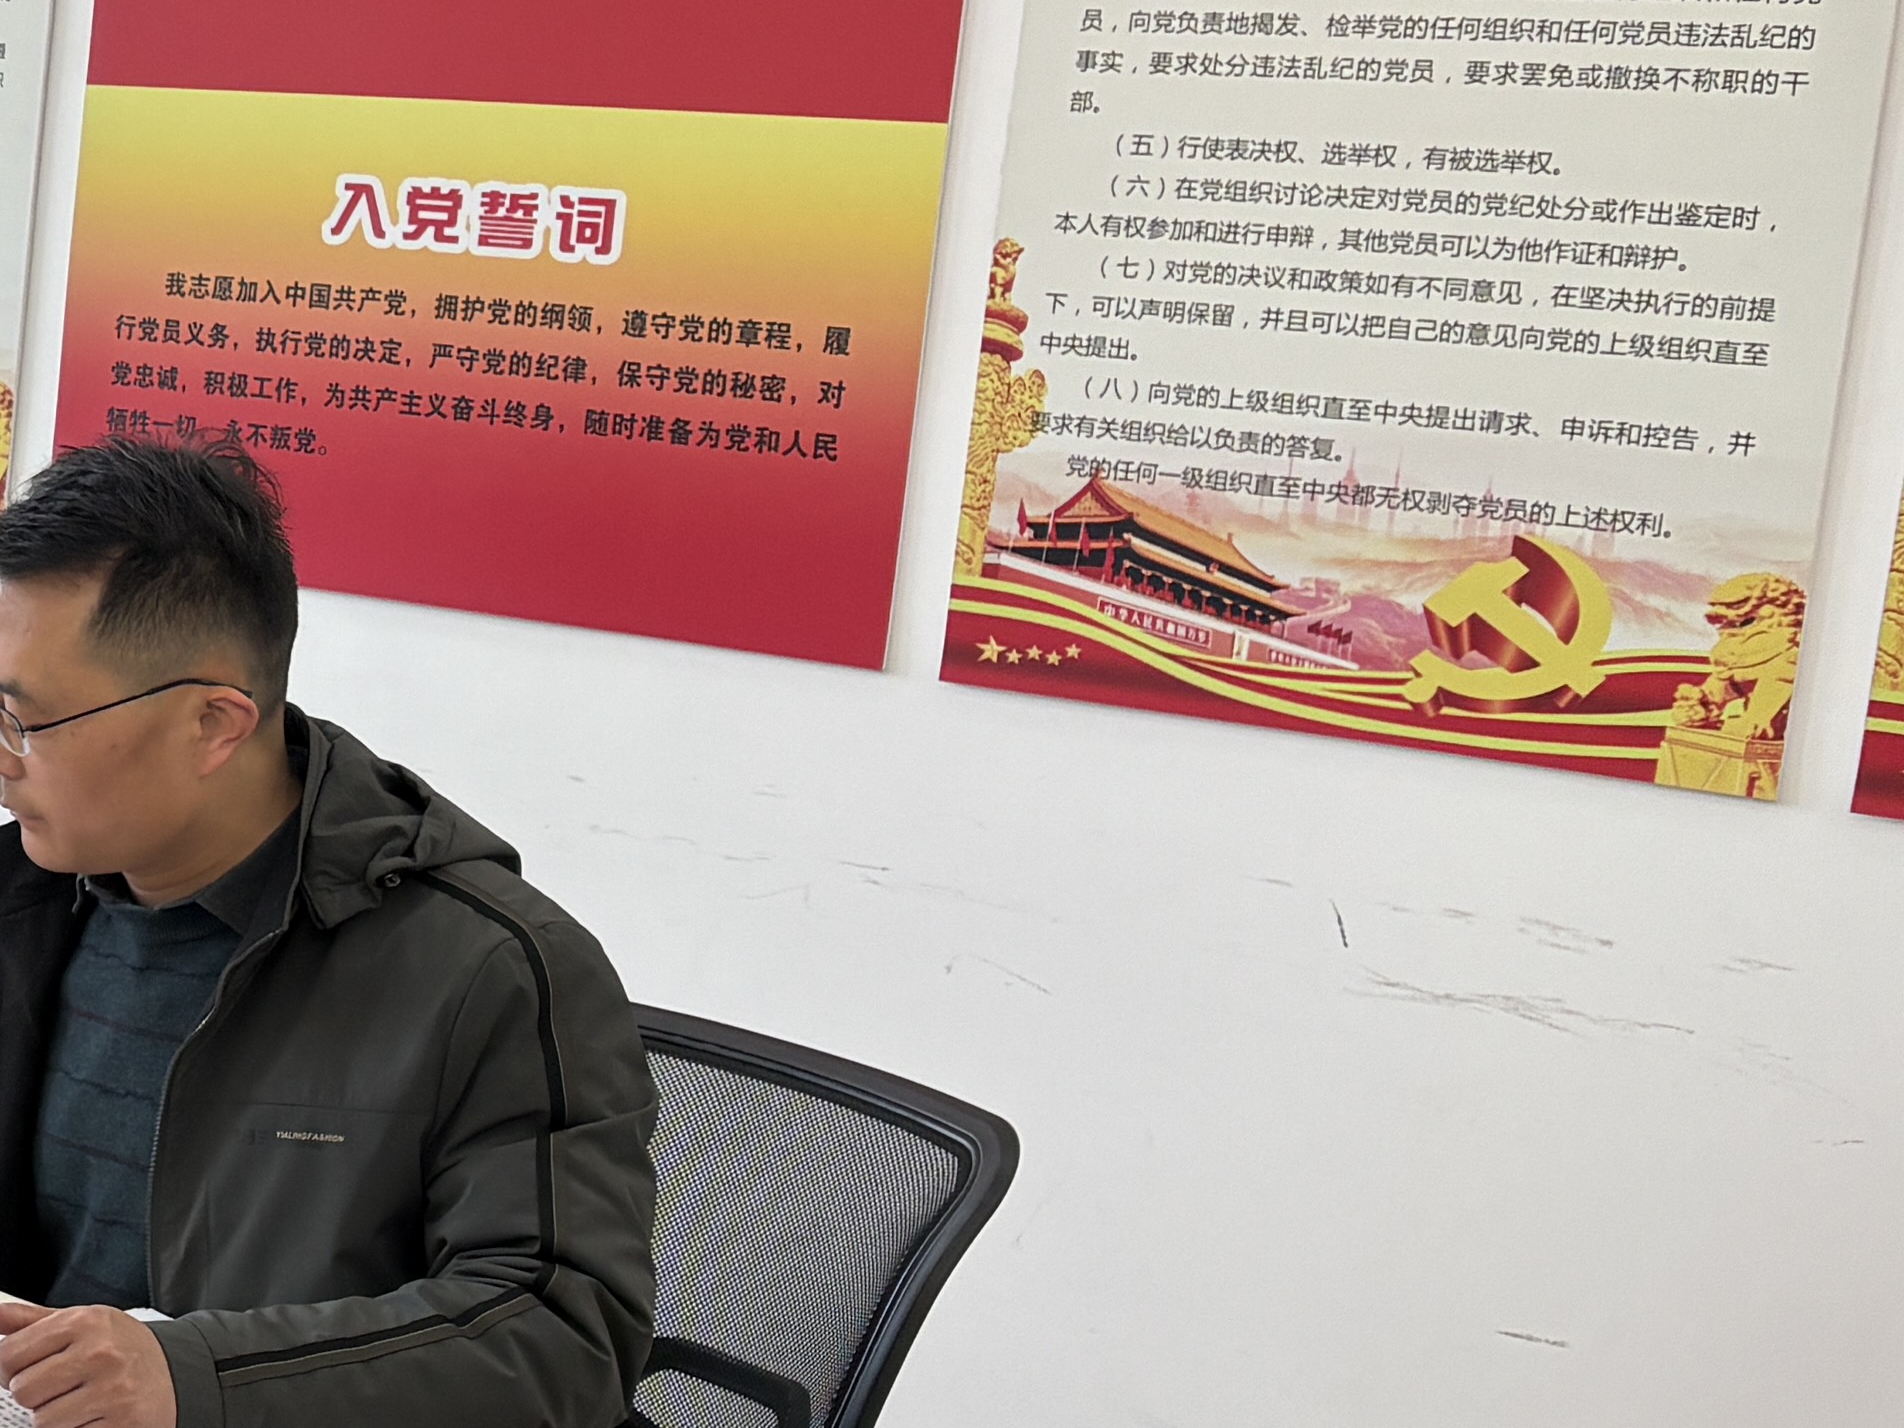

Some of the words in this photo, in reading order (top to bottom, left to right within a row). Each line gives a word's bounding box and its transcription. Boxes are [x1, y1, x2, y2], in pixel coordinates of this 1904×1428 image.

[1080, 8, 1817, 52] 员，向党负责地揭发、检举党的任何组织和任何党员违法乱纪的
[1070, 89, 1102, 115] 部。
[1075, 49, 1810, 98] 事实，要求处分违法乱纪的党员，要求罢免或撤换不称职的干
[1114, 133, 1563, 178] （五）行使表决权、选举权，有被选举权。
[326, 178, 621, 260] 入党誓词
[1108, 174, 1779, 235] （六）在党组织讨论决定对党员的党纪处分或作出鉴定时，
[1053, 211, 1693, 273] 本人有权参加和进行申辩，其他党员可以为他作证和辩护。
[164, 270, 853, 359] 我志愿加入中国共产党，拥护党的纲领，遵守党的章程，履
[1097, 254, 1776, 325] （七）对党的决议和政策如有不同意见，在坚决执行的前提
[1039, 331, 1141, 364] 中央提出。
[1046, 291, 1770, 368] 下，可以声明保留，并且可以把自己的意见向党的上级组织直至
[114, 313, 847, 411] 行党员义务，执行党的决定，严守党的纪律，保守党的秘密，对
[106, 406, 327, 456] 牺牲一切永不叛党。
[110, 360, 839, 463] 党忠诚，积极工作，为共产主义奋斗终身，随时准备为党和人民
[1030, 411, 1344, 463] 要求有关组织给以负责的答复。
[1084, 374, 1757, 460] （八）向党的上级组织直至中央提出请求、申诉和控告，并
[1065, 453, 1674, 540] 党的任何一级组织直至中央都无权剥夺党员的上述权利。
